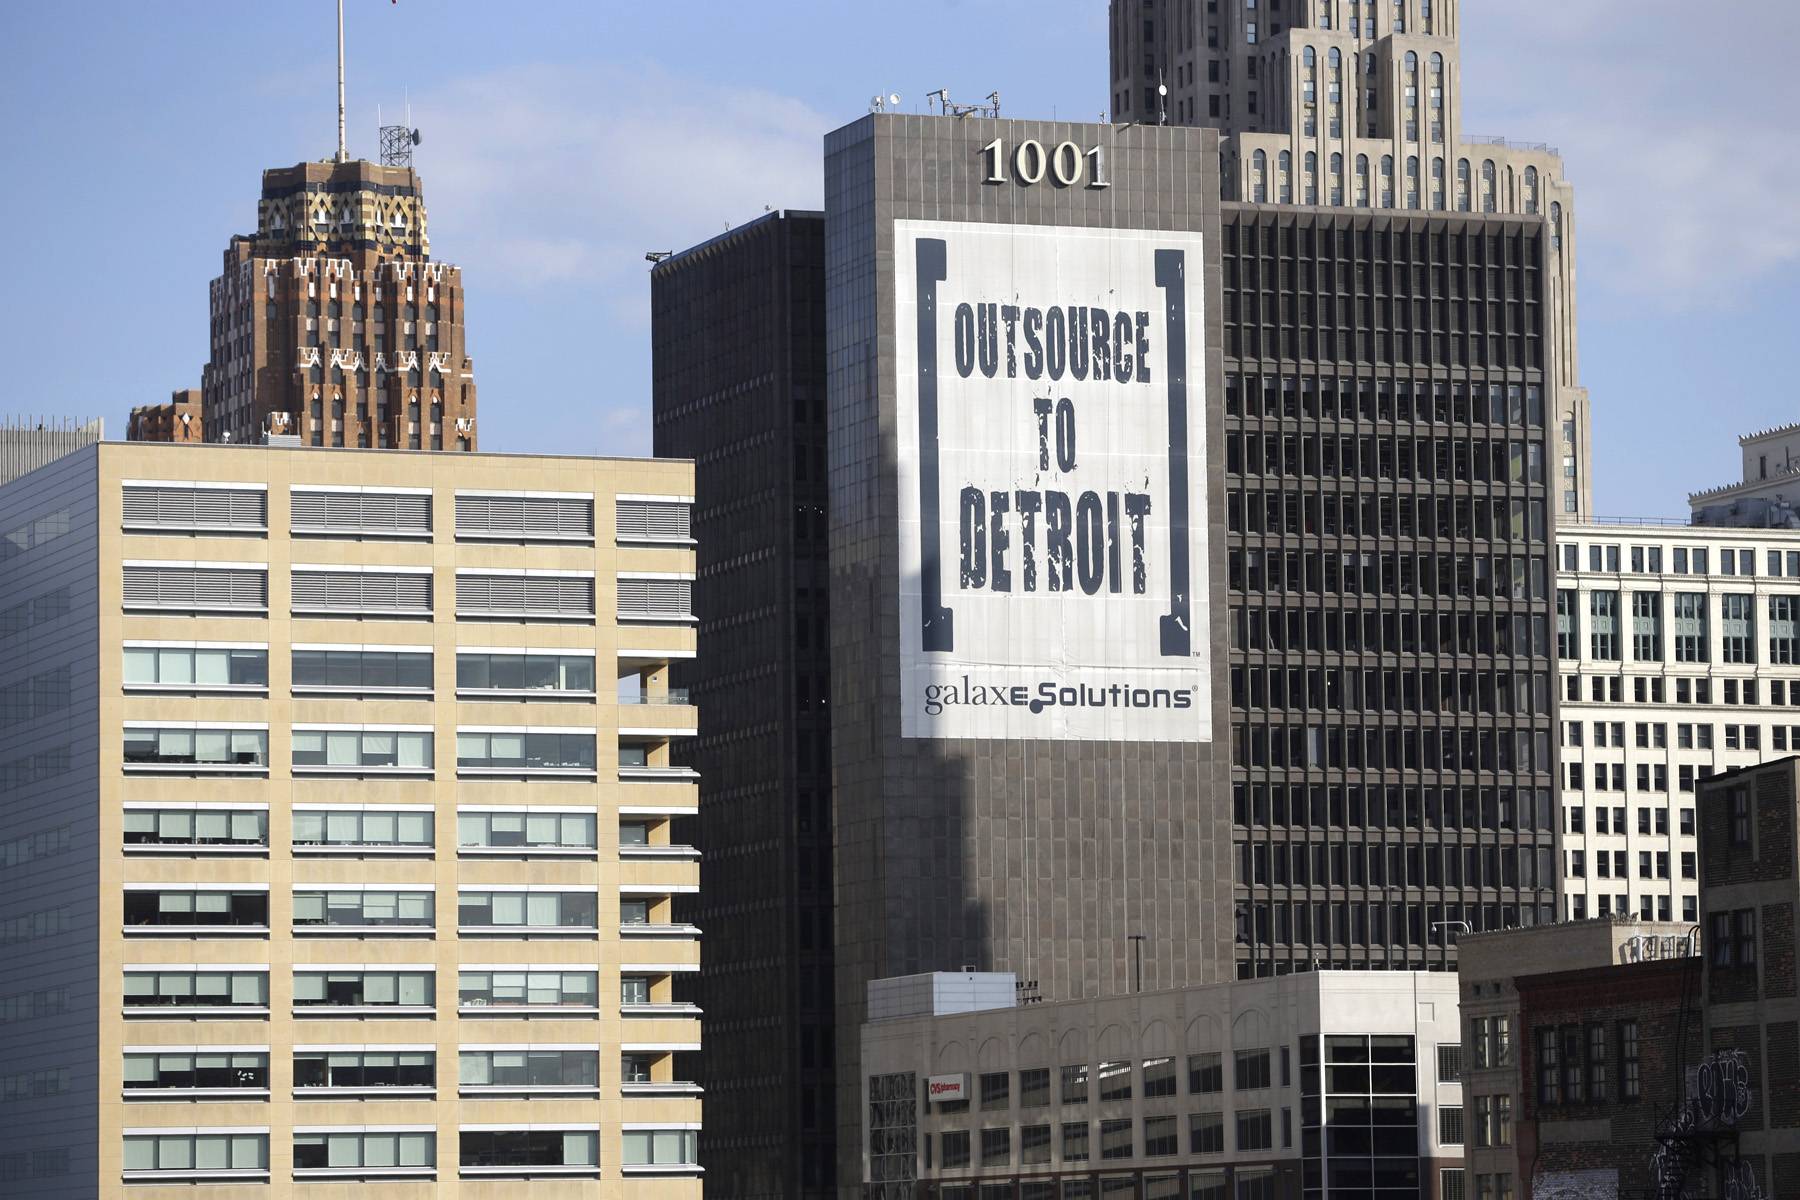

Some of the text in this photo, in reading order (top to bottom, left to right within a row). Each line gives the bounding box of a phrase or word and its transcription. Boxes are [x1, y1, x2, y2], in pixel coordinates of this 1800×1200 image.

[982, 138, 1111, 187] 1001
[954, 302, 1151, 384] OUTSOURCE
[1033, 397, 1077, 473] TO
[959, 487, 1152, 595] DETROIT
